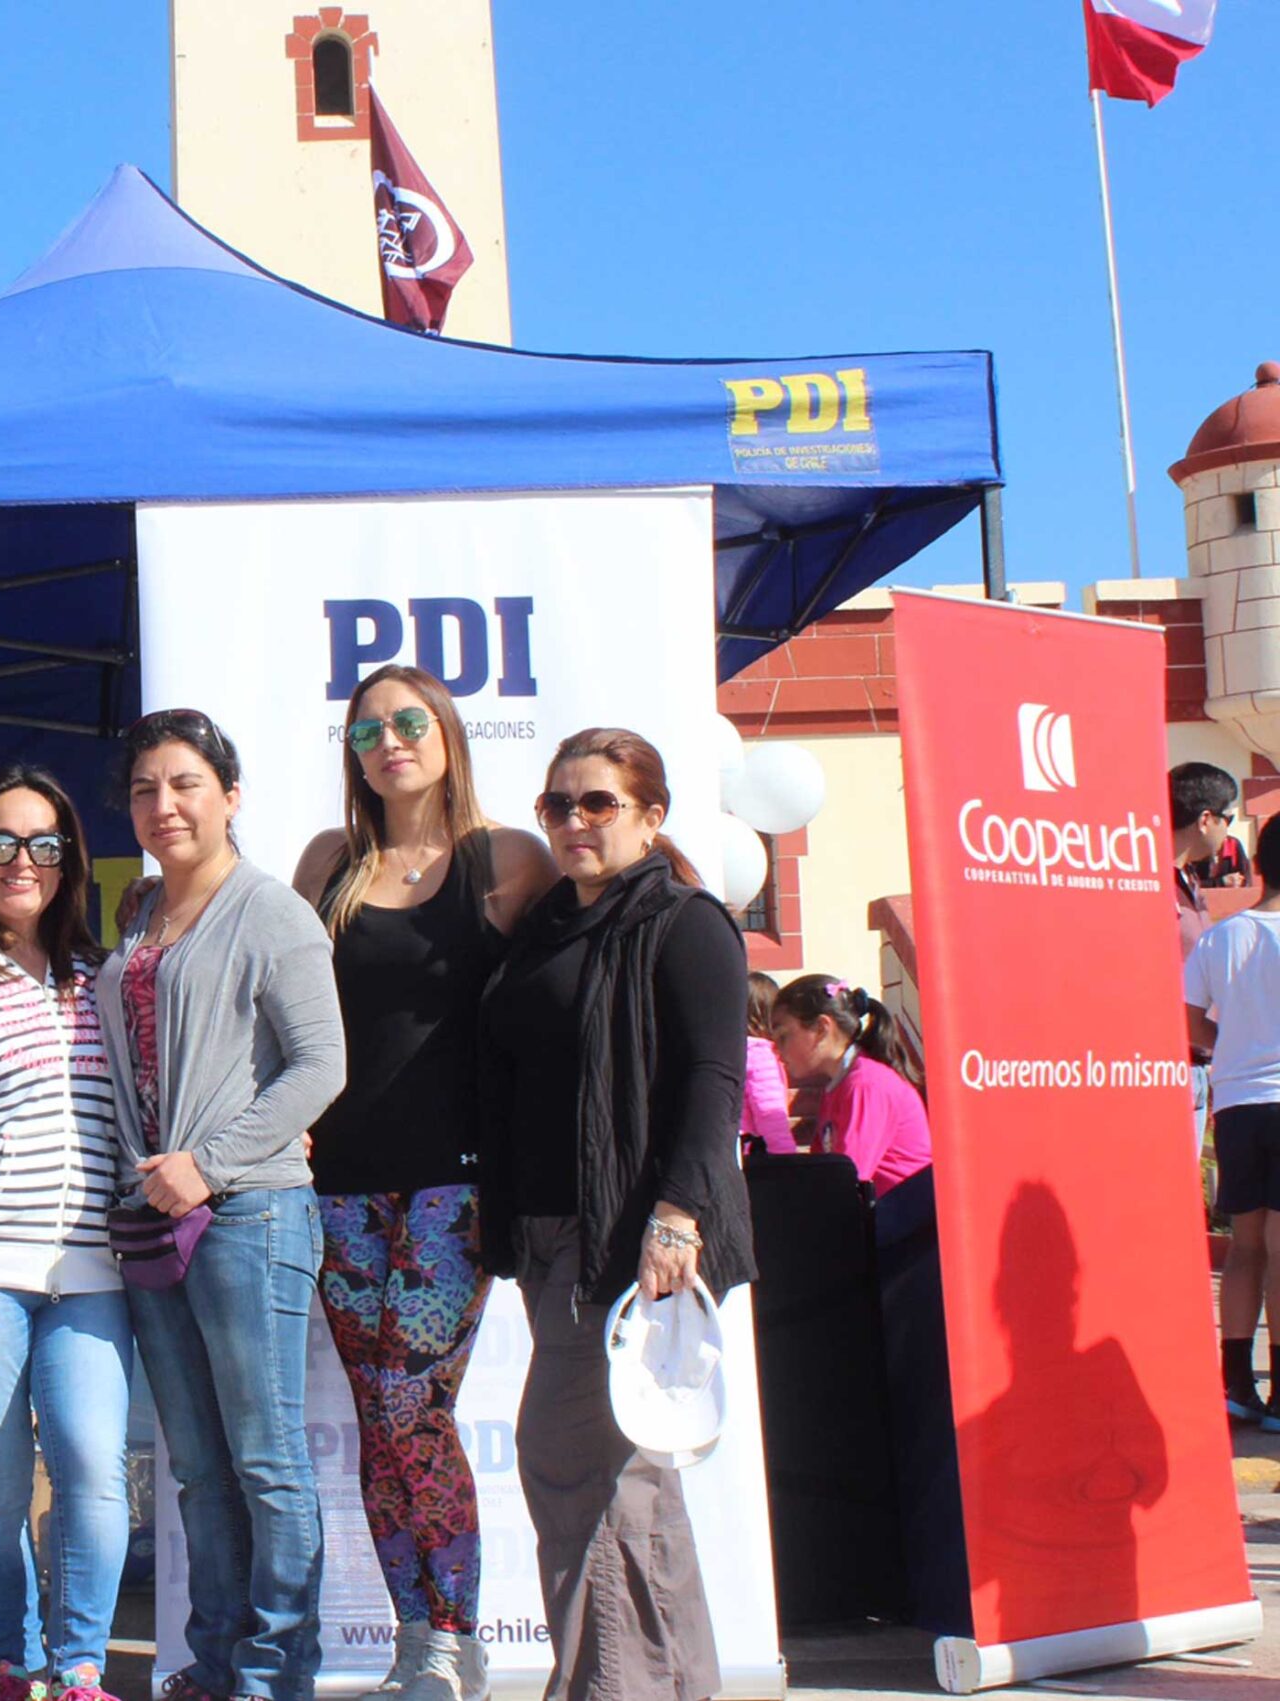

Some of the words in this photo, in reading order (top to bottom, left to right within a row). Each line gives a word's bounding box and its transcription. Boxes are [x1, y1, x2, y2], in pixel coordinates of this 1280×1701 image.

[724, 368, 872, 435] PDI
[801, 455, 827, 469] CHILE
[323, 596, 538, 701] PDI
[465, 721, 536, 741] GACIONES
[958, 798, 1158, 885] Coopeuch
[964, 866, 1039, 886] COOPERATIVA
[1051, 873, 1065, 887] DE
[1067, 874, 1104, 891] AHORRO
[1107, 877, 1115, 891] Y
[1117, 877, 1161, 893] CREDITO
[960, 1049, 1082, 1092] Queremos
[1086, 1049, 1108, 1088] lo
[1111, 1053, 1188, 1089] mismo
